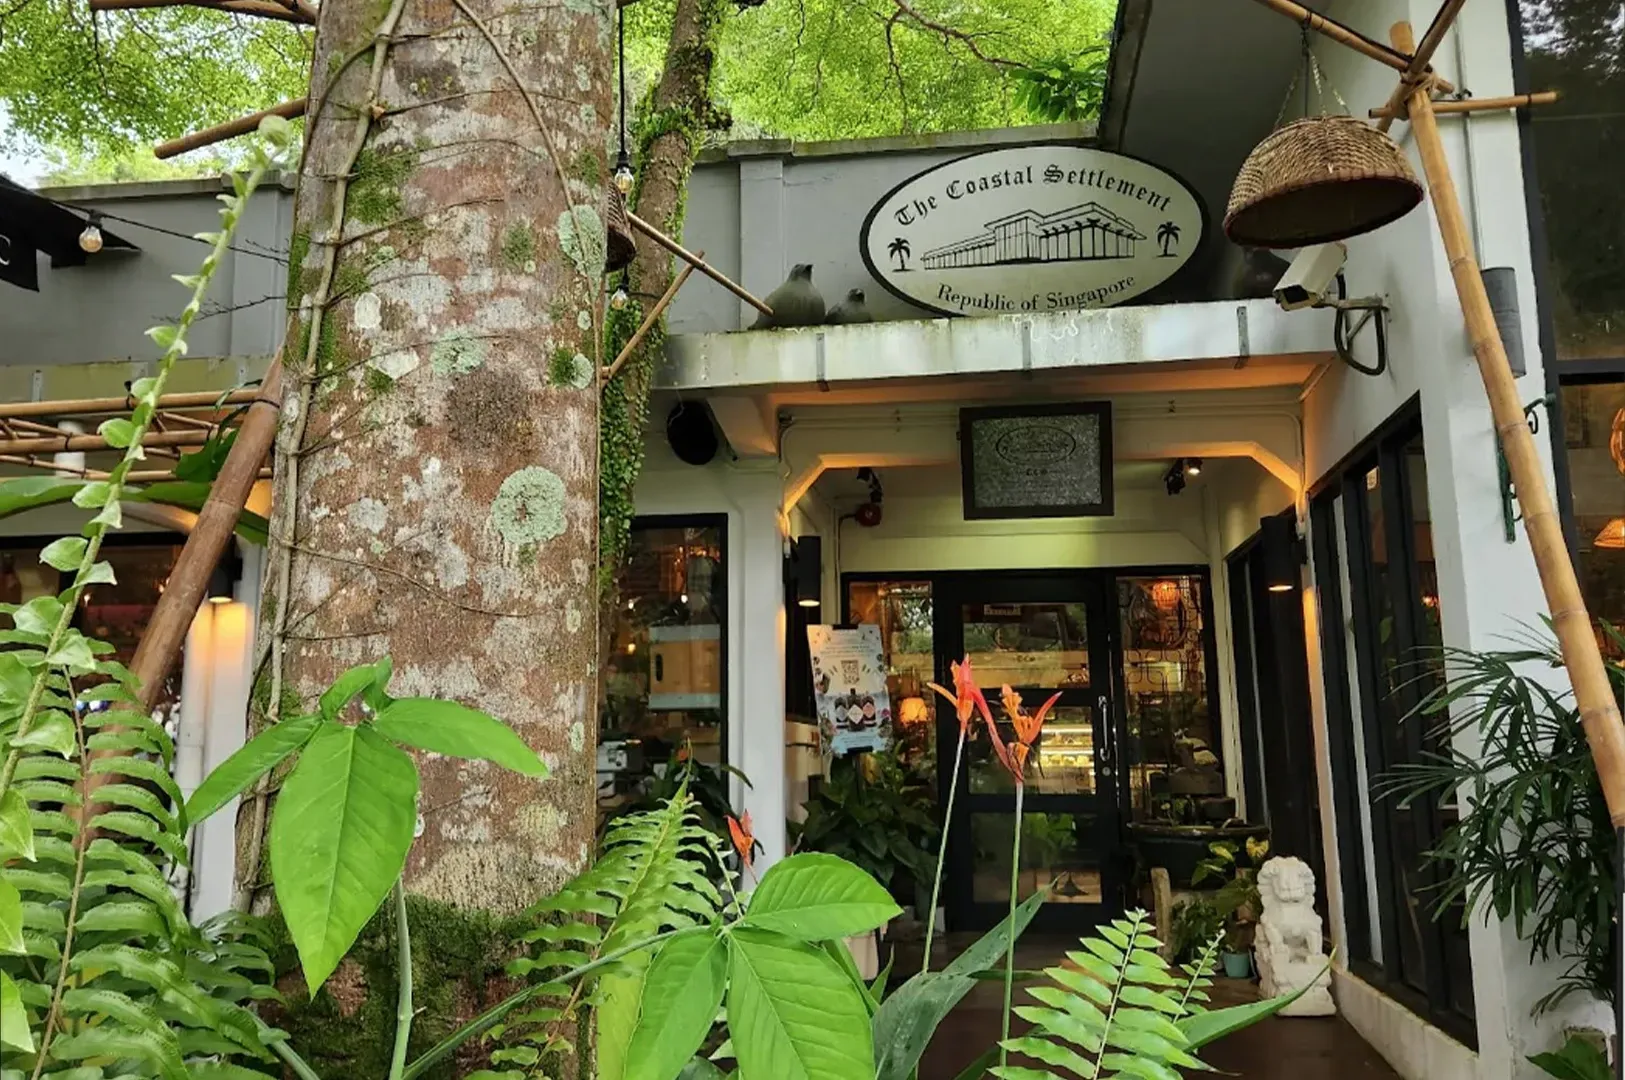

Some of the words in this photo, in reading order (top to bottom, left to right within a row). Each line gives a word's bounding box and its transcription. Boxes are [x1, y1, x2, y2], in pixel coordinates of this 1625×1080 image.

[893, 195, 938, 226] The
[946, 165, 1033, 200] Coastal
[1043, 164, 1173, 213] Settlement
[936, 282, 1016, 311] Republic
[1020, 295, 1040, 311] of
[1046, 276, 1136, 309] Singapore
